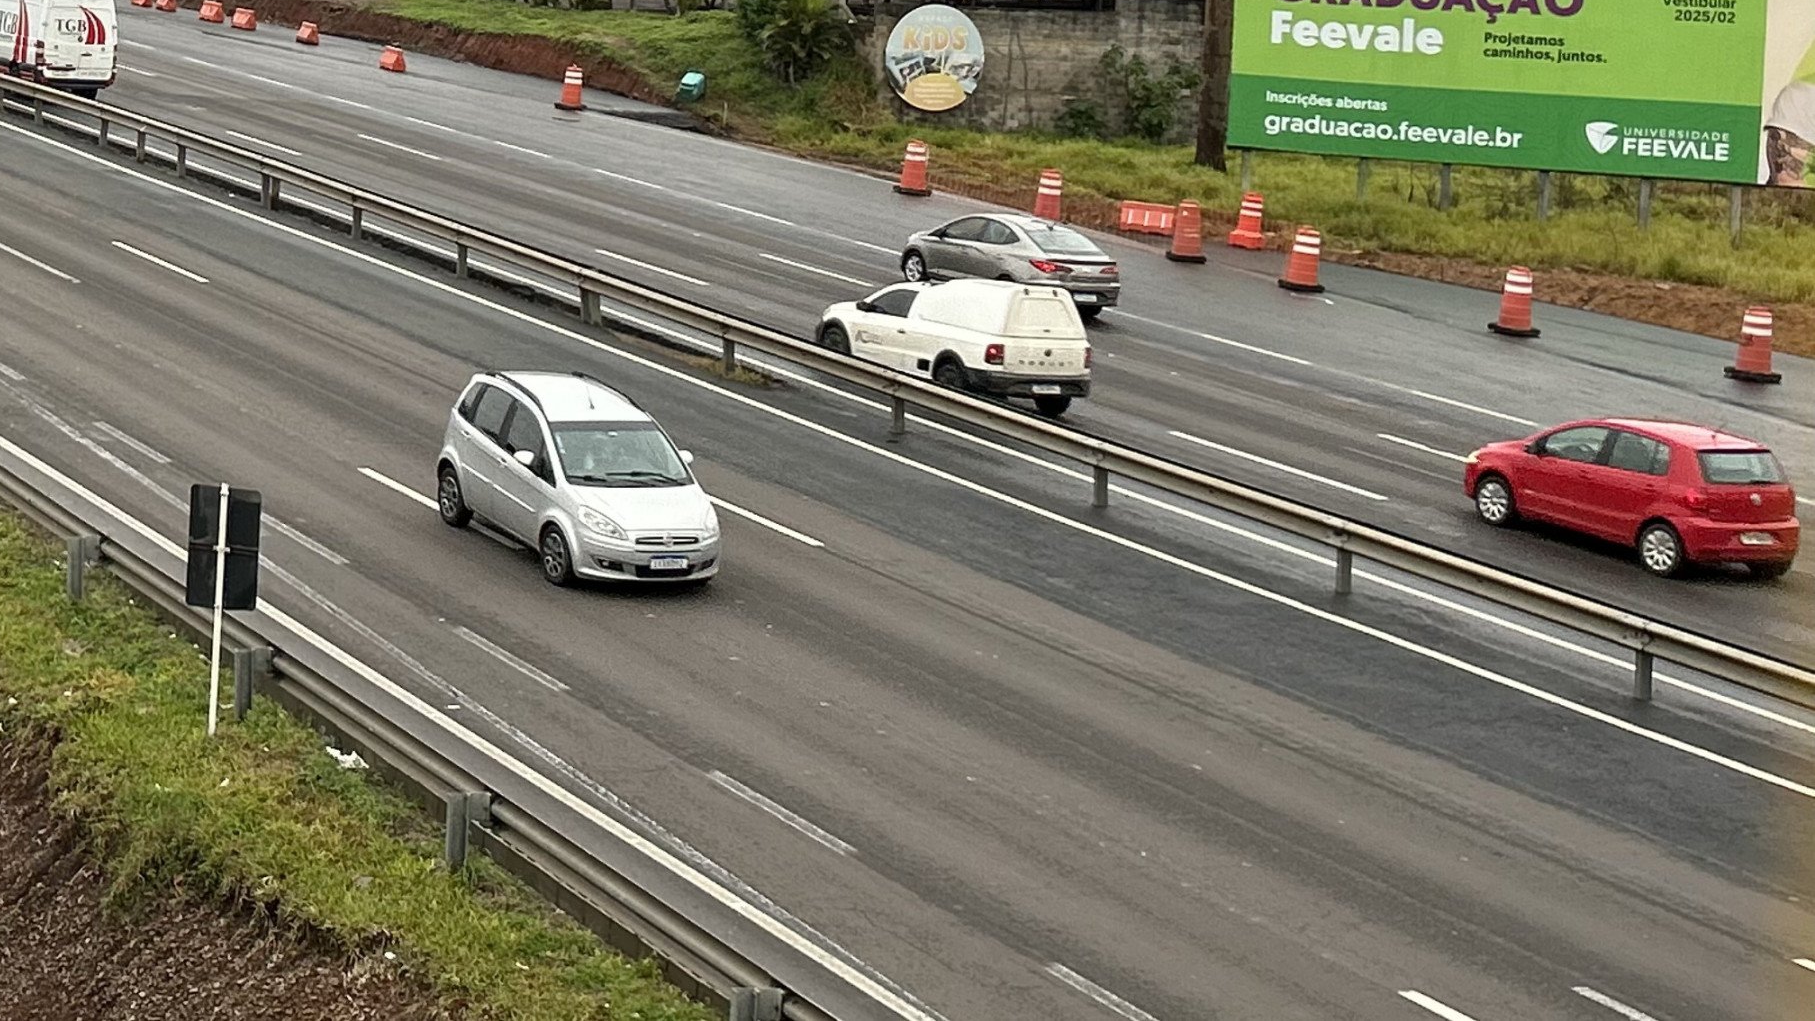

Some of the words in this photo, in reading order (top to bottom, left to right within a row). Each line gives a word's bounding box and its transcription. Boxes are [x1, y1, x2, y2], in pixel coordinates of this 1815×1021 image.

[1674, 9, 1736, 24] 2025/02
[56, 18, 87, 33] TGB
[1270, 10, 1444, 55] Feevale
[1484, 32, 1566, 48] Projetamos
[1483, 47, 1555, 62] caminhos,
[1556, 49, 1608, 64] juntos.
[1266, 90, 1333, 109] Inscrições
[1335, 94, 1388, 112] abertas
[1264, 114, 1523, 149] graduacao.feevale.br
[1623, 127, 1729, 141] UNIVERSIDADE
[1622, 139, 1729, 162] FEEVALE
